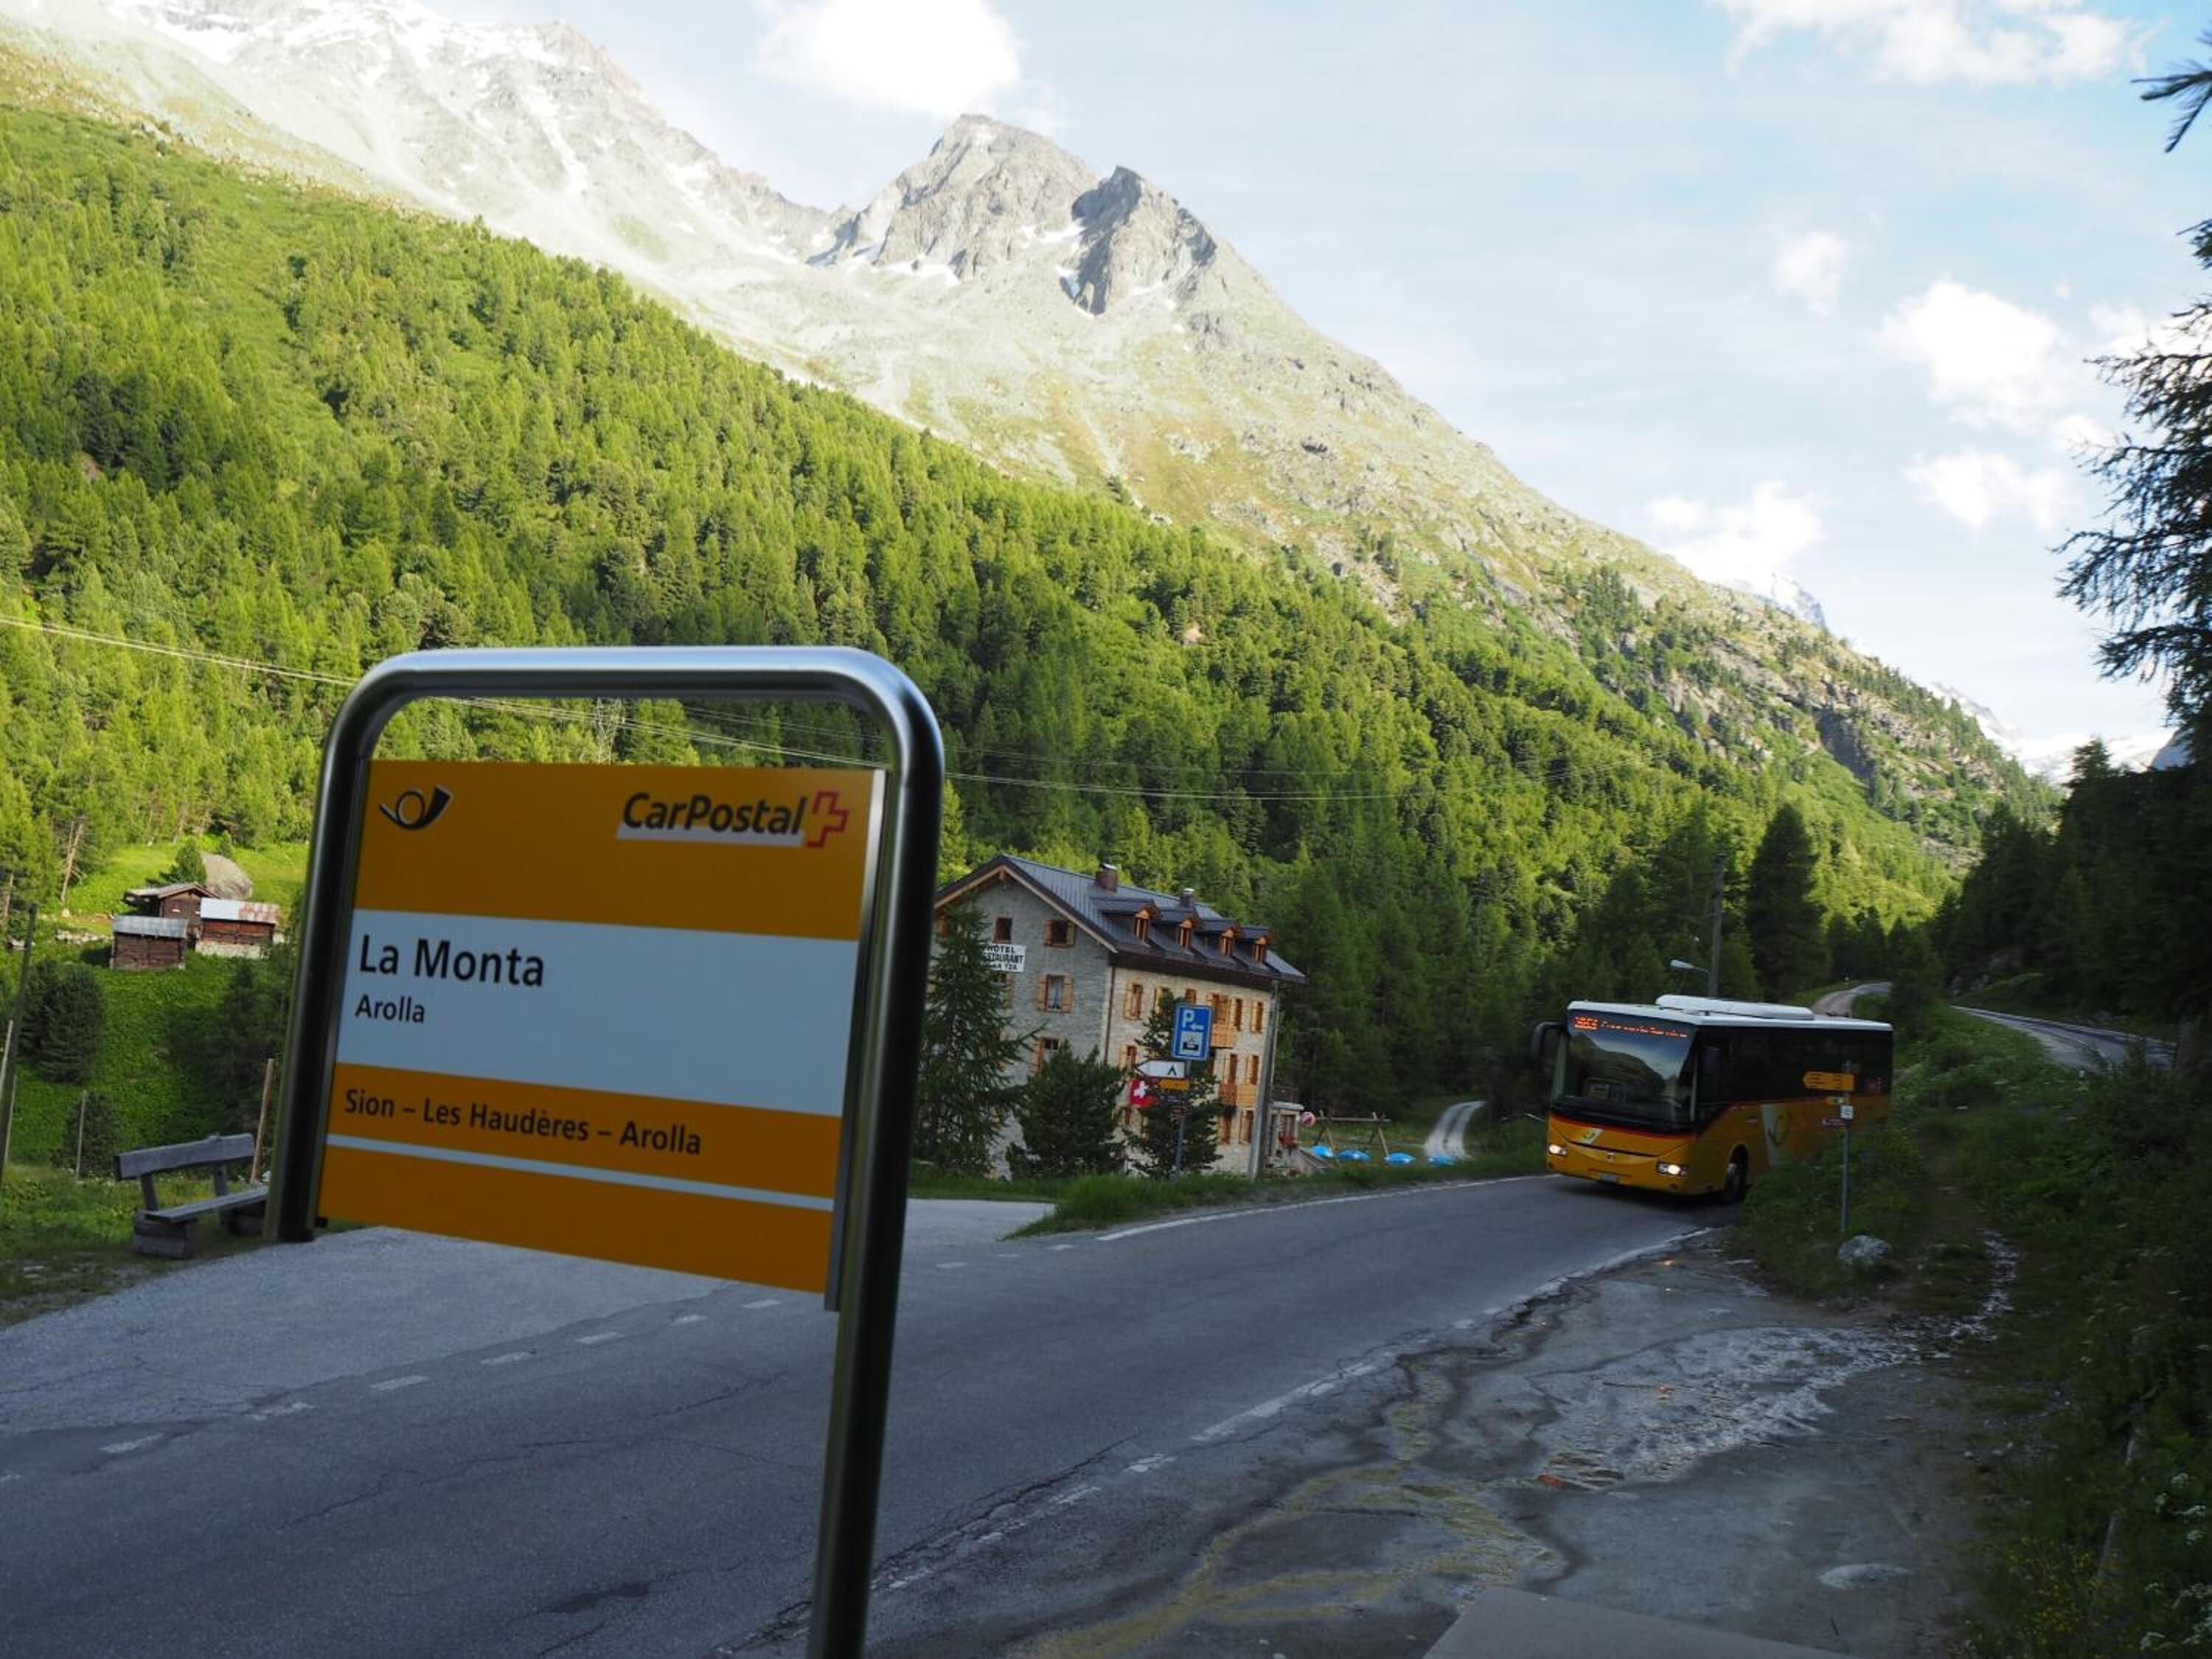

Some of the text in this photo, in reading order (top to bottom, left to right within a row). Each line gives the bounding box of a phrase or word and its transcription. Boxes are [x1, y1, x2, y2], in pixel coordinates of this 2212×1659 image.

[622, 791, 808, 836] CarPostal
[359, 933, 544, 988] La Monta
[983, 952, 1023, 964] ESTAURANT
[354, 993, 426, 1024] Arolla
[1182, 1009, 1194, 1029] P
[344, 1088, 396, 1119] Sion
[423, 1096, 462, 1127] Les
[469, 1102, 589, 1142] Haudères
[619, 1119, 702, 1155] Arolla
